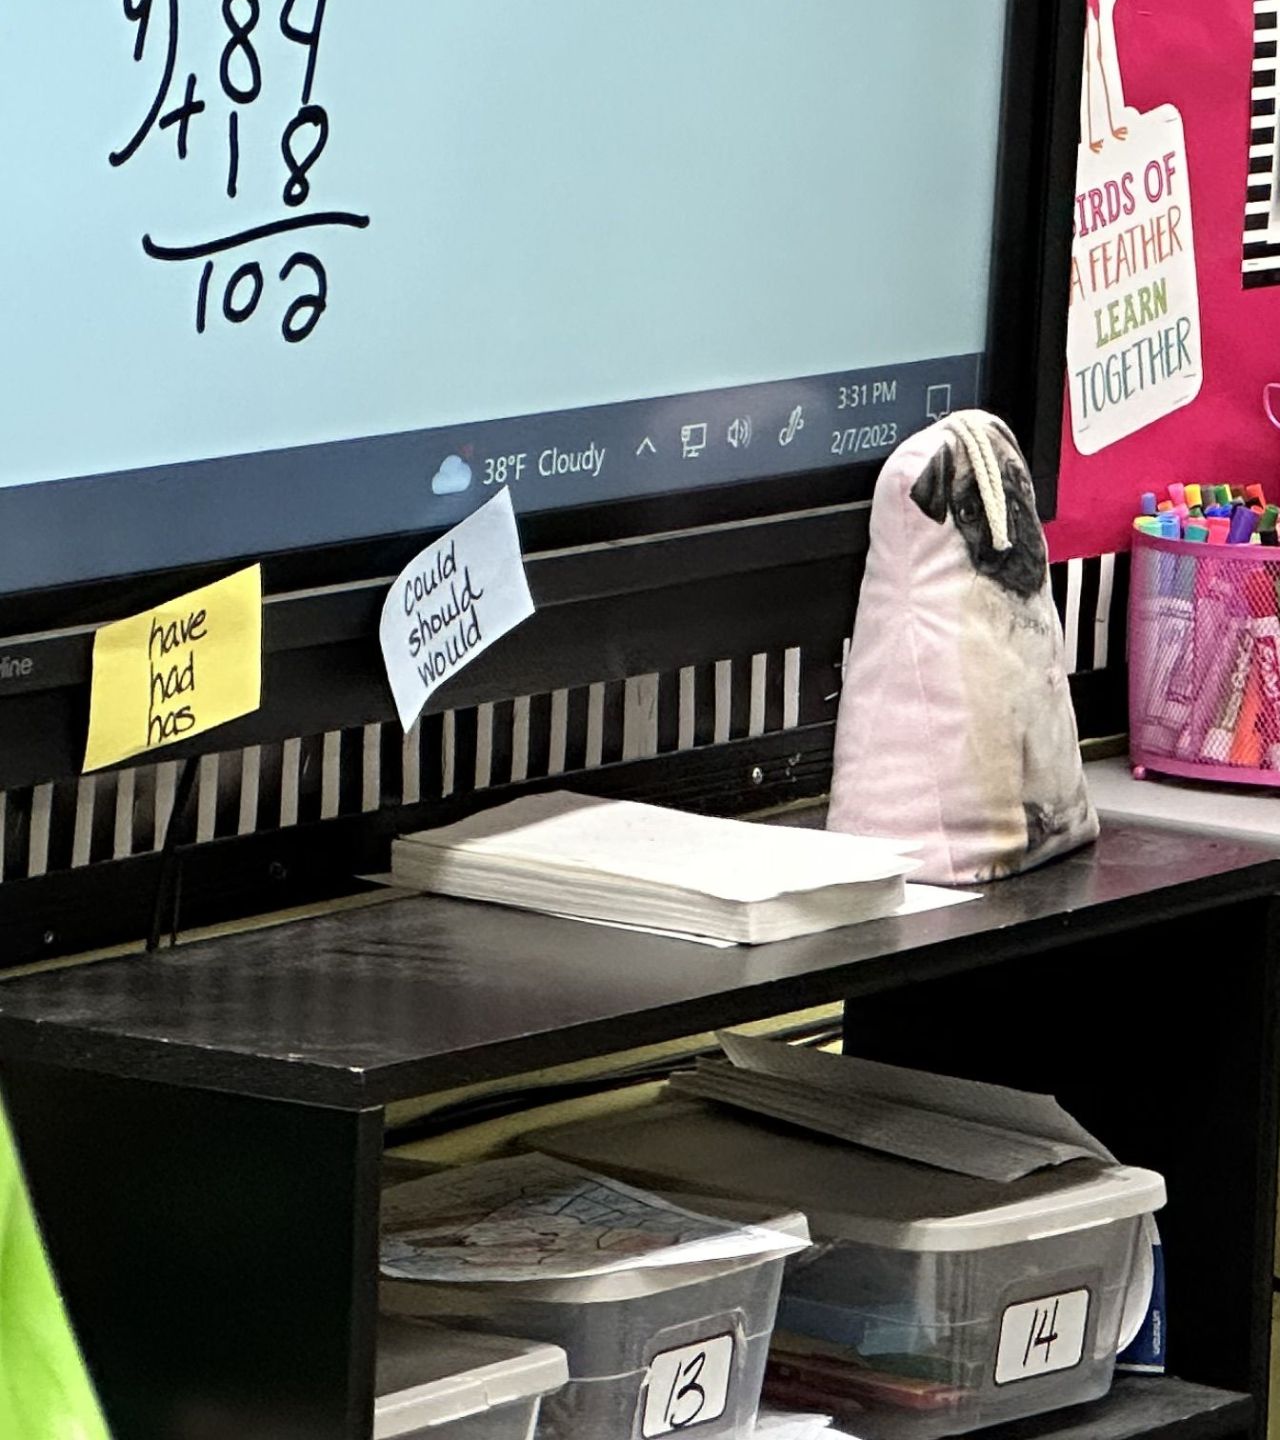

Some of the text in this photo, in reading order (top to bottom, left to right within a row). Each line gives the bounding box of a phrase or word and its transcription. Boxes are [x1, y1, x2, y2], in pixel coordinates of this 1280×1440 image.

[1073, 150, 1176, 238] IRDS OF
[1089, 205, 1183, 292] FEATHER
[196, 251, 328, 343] 102
[1095, 277, 1168, 350] LEARN
[837, 379, 897, 410] 3:31 PM
[1075, 315, 1192, 419] TOGETHER
[482, 441, 606, 486] 38°F Cloudy
[830, 421, 898, 455] 2/7/2023
[404, 541, 457, 617] could
[408, 565, 484, 658] should
[149, 609, 208, 660] have
[417, 603, 482, 688] would
[150, 650, 195, 704] had
[147, 704, 196, 747] has
[1022, 1297, 1059, 1368] 14
[663, 1350, 707, 1428] 13
